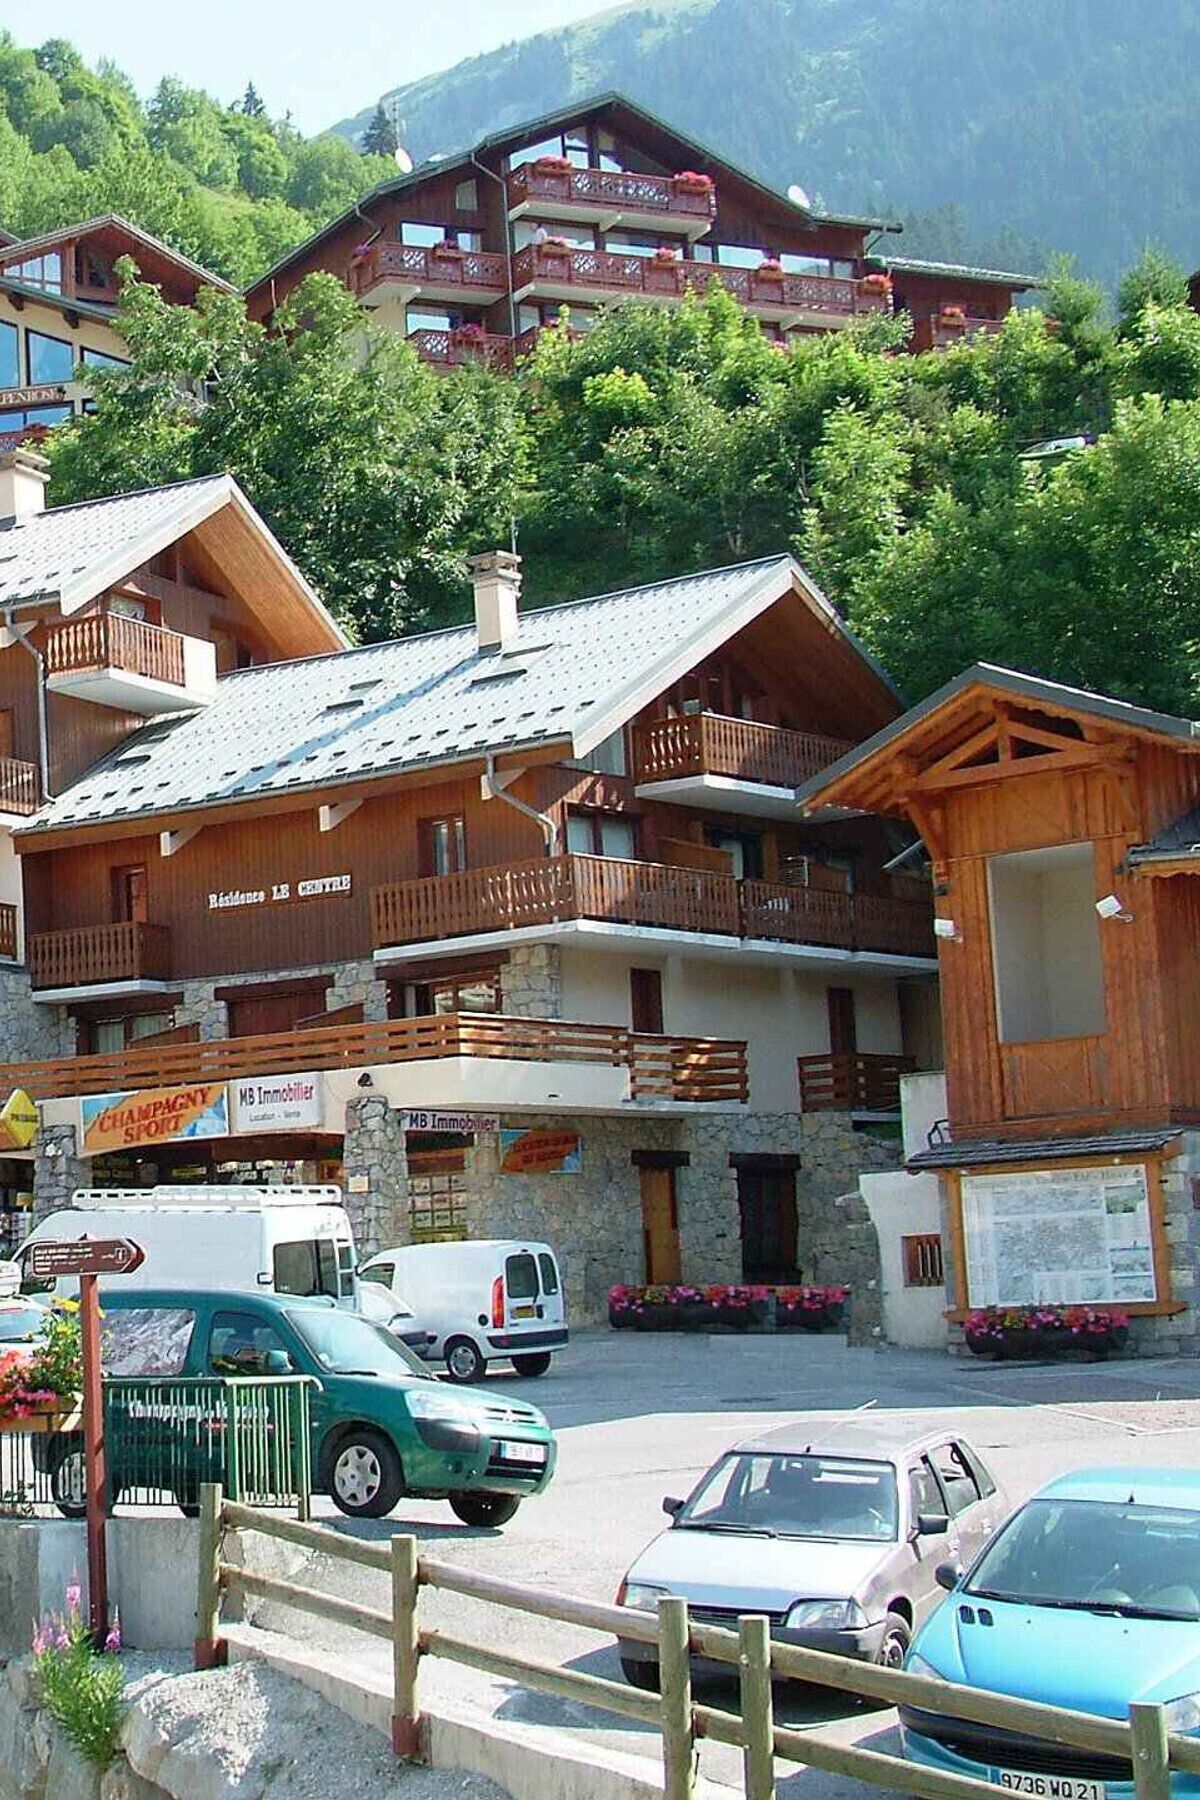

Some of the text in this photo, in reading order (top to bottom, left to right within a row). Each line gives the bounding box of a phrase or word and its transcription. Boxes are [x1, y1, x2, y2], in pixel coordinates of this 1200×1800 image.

[239, 1083, 314, 1107] MB Immobilier
[100, 1087, 212, 1132] CHAMPAGNY
[409, 1113, 496, 1131] MB Immobilier
[123, 1116, 182, 1144] SPORT
[1001, 1773, 1098, 1800] 9736 WQ 21
